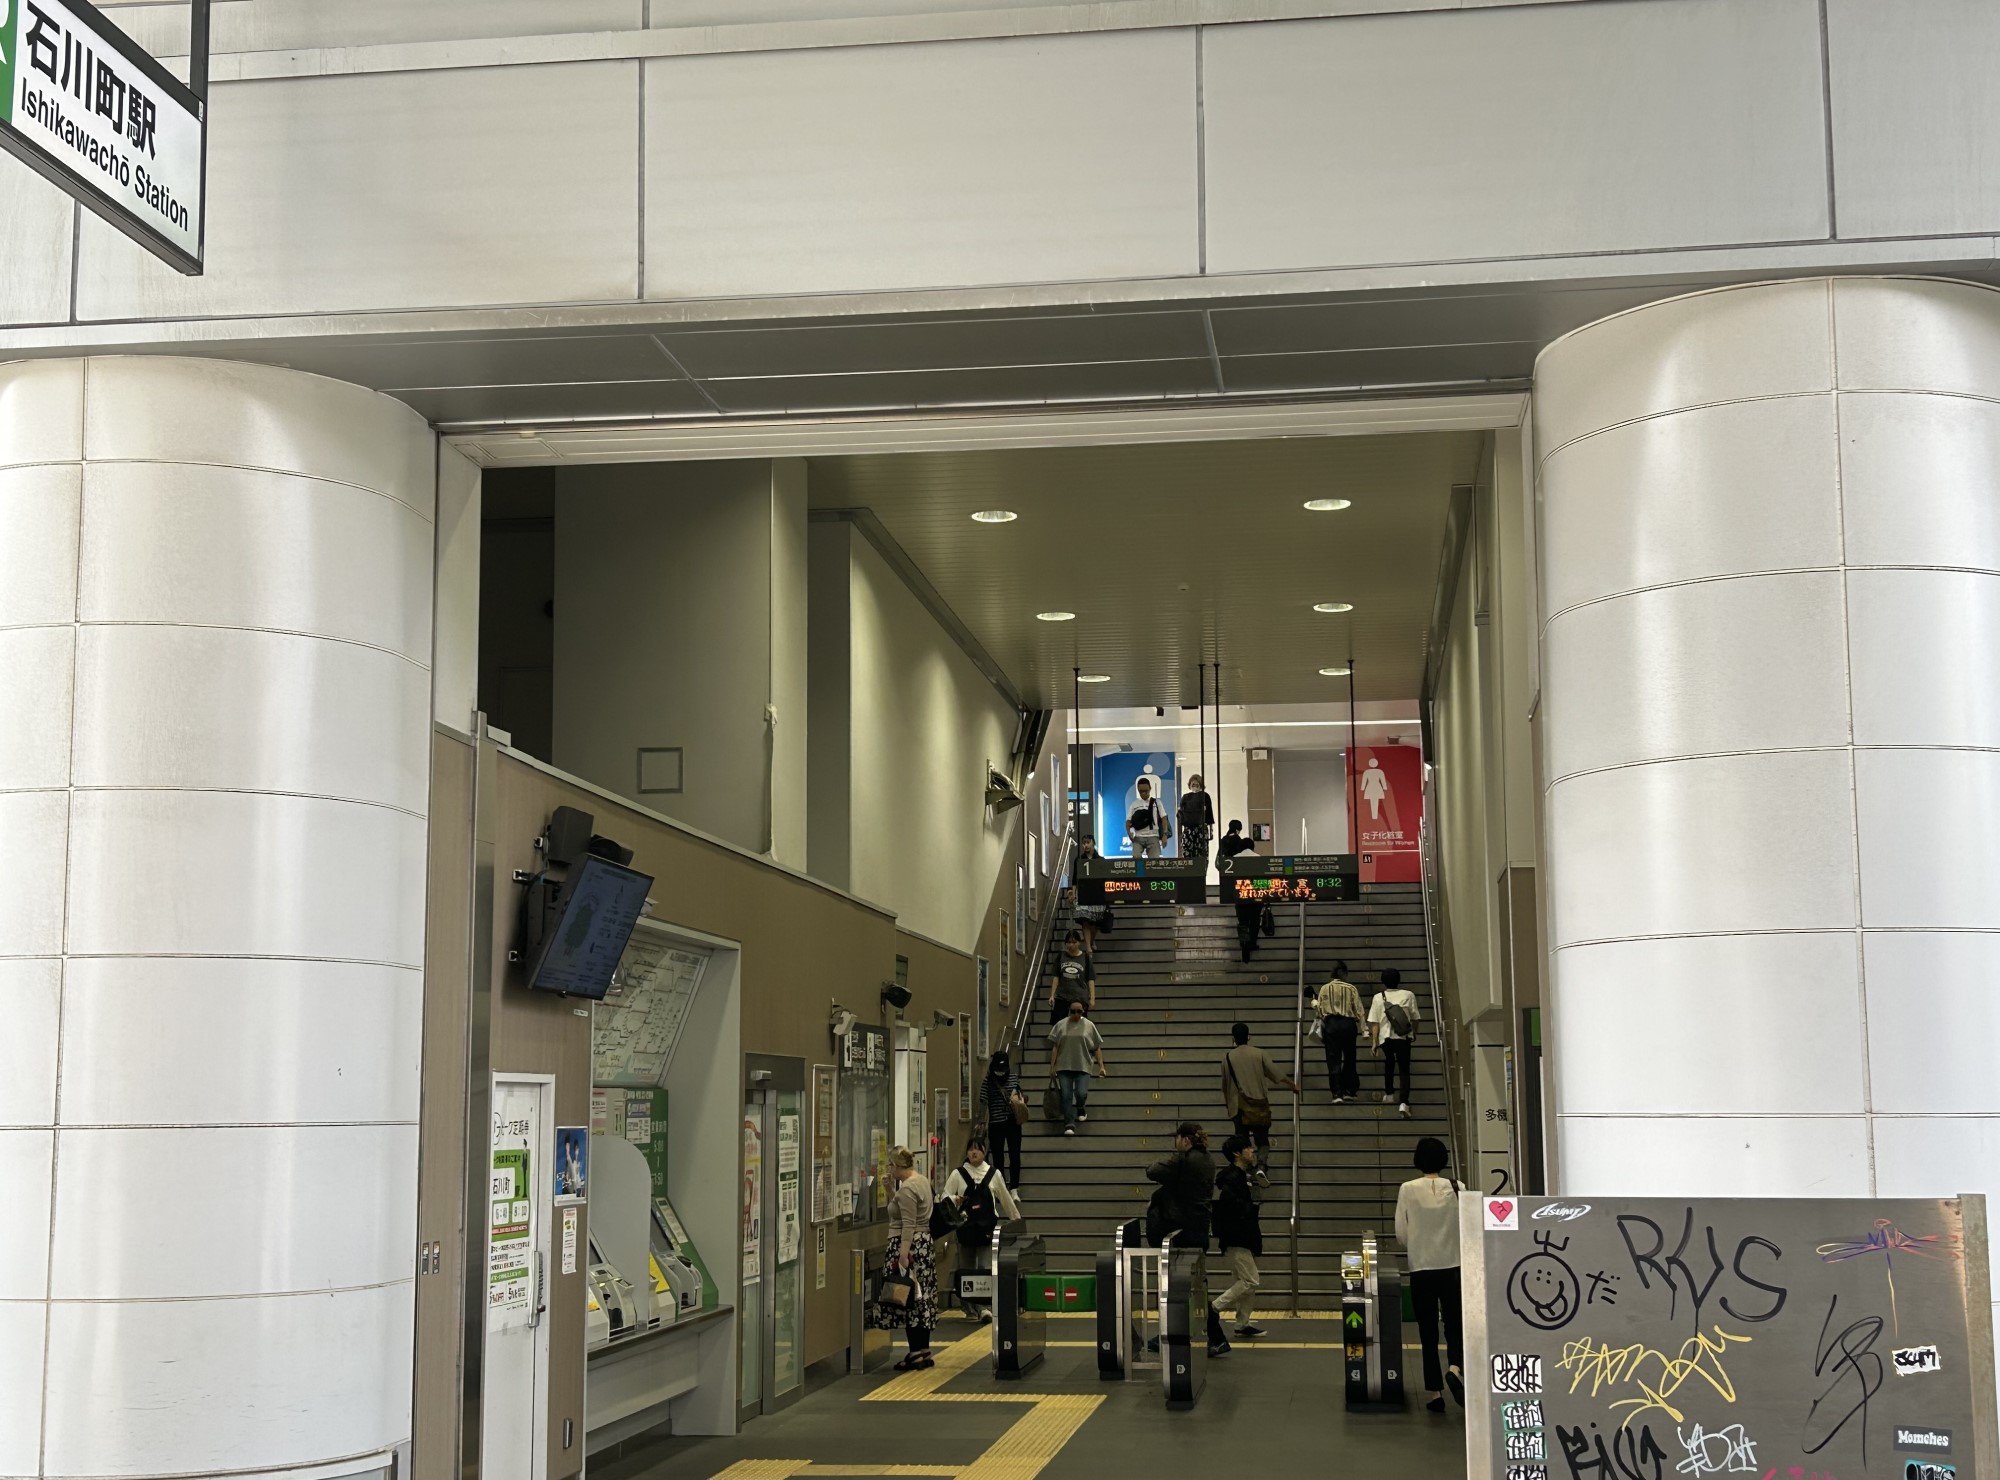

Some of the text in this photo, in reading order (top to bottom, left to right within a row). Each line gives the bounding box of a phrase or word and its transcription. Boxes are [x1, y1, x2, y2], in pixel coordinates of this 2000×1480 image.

[26, 3, 156, 160] 石川町駅
[21, 77, 188, 231] Ishikawachō Station
[1083, 861, 1090, 876] 1
[1224, 859, 1234, 874] 2
[1150, 880, 1175, 891] 8:30
[1316, 877, 1342, 888] 8:32
[1490, 1168, 1509, 1195] 2
[1897, 1430, 1949, 1447] Momches
